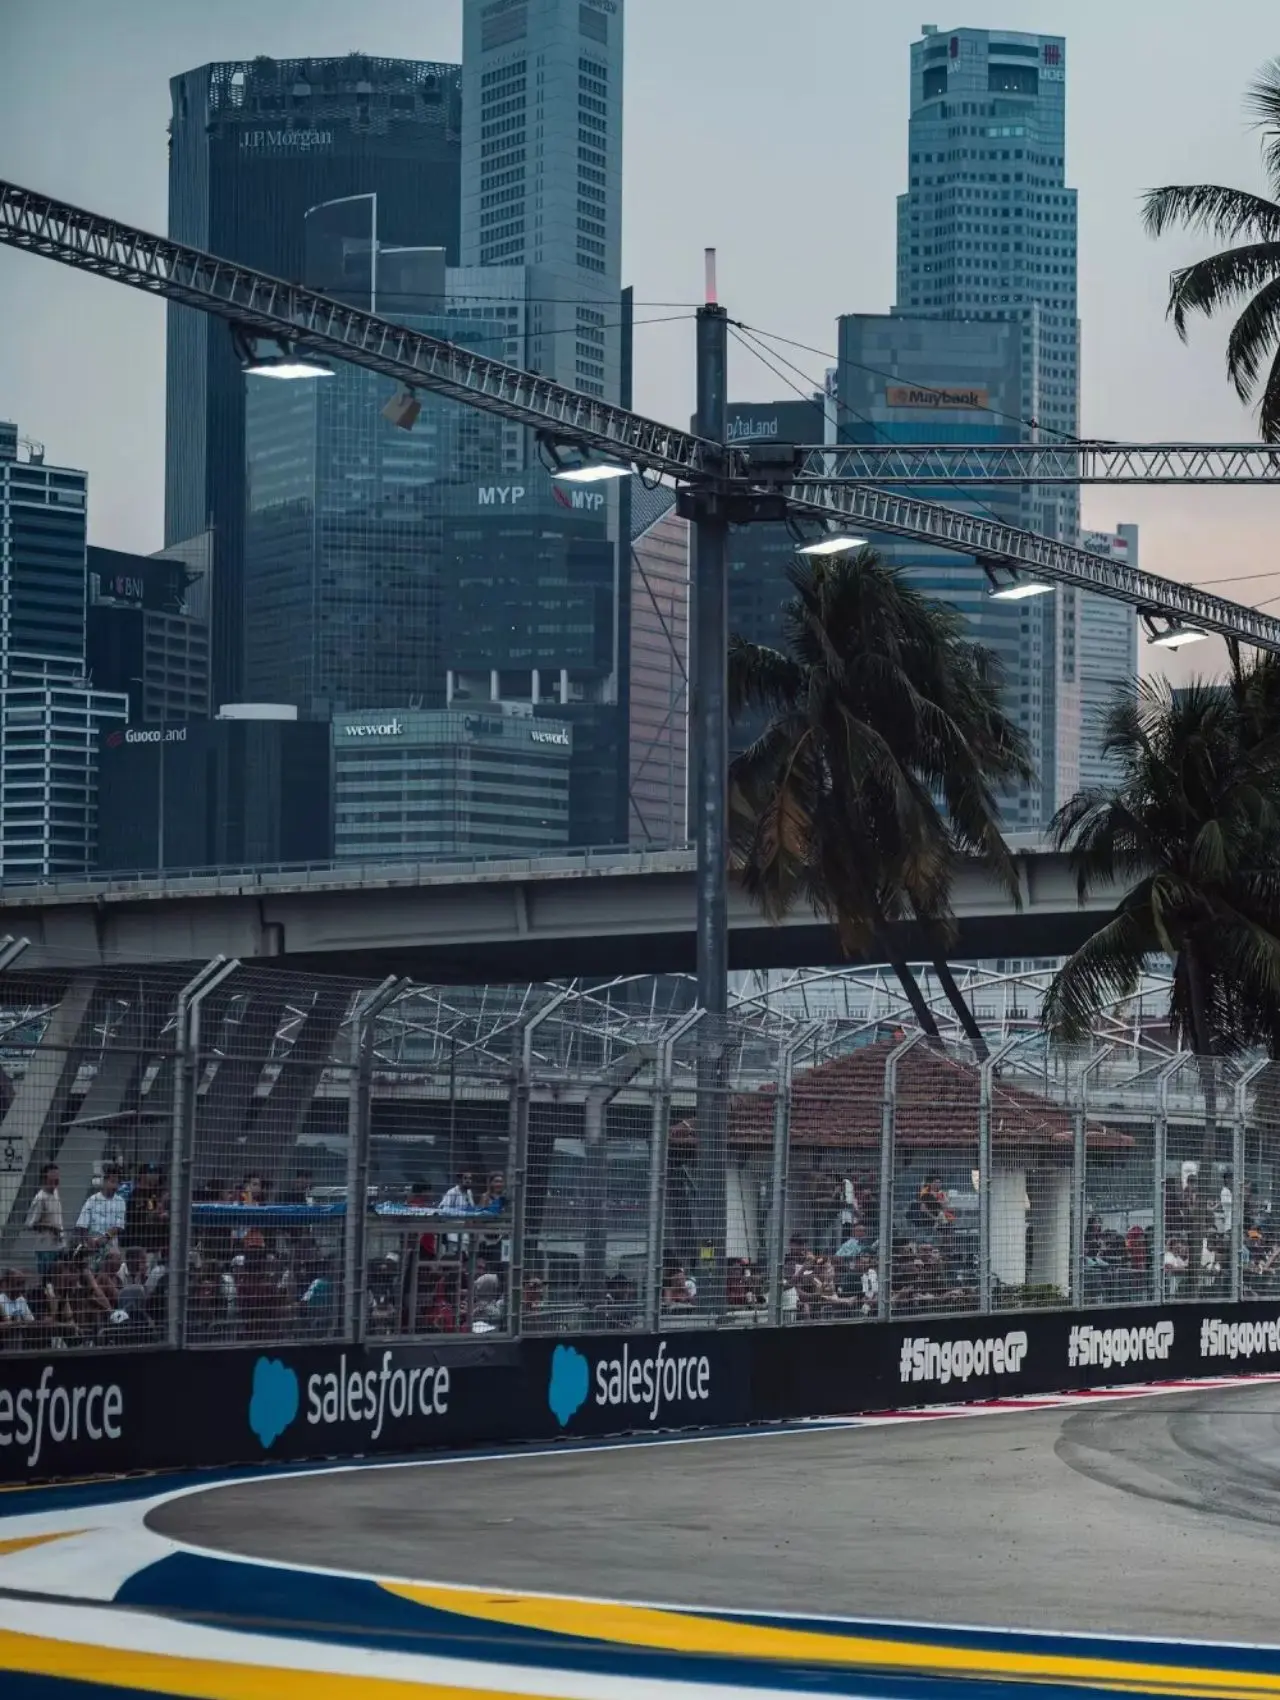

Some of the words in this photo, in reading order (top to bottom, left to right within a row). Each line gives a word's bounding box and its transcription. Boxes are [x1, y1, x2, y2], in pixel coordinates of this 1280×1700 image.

[727, 415, 778, 440] pitaLand
[478, 486, 525, 505] MYP
[571, 490, 604, 511] MYP
[125, 577, 144, 599] BNI
[125, 727, 188, 743] Guocoand
[345, 718, 404, 737] wework
[530, 728, 570, 746] wework
[900, 1331, 1028, 1384] #SingaporeGP
[1068, 1320, 1174, 1369] #SingaporeGP
[596, 1341, 710, 1421] salesforce
[307, 1350, 449, 1440] salesforce
[0, 1366, 123, 1467] esforce
